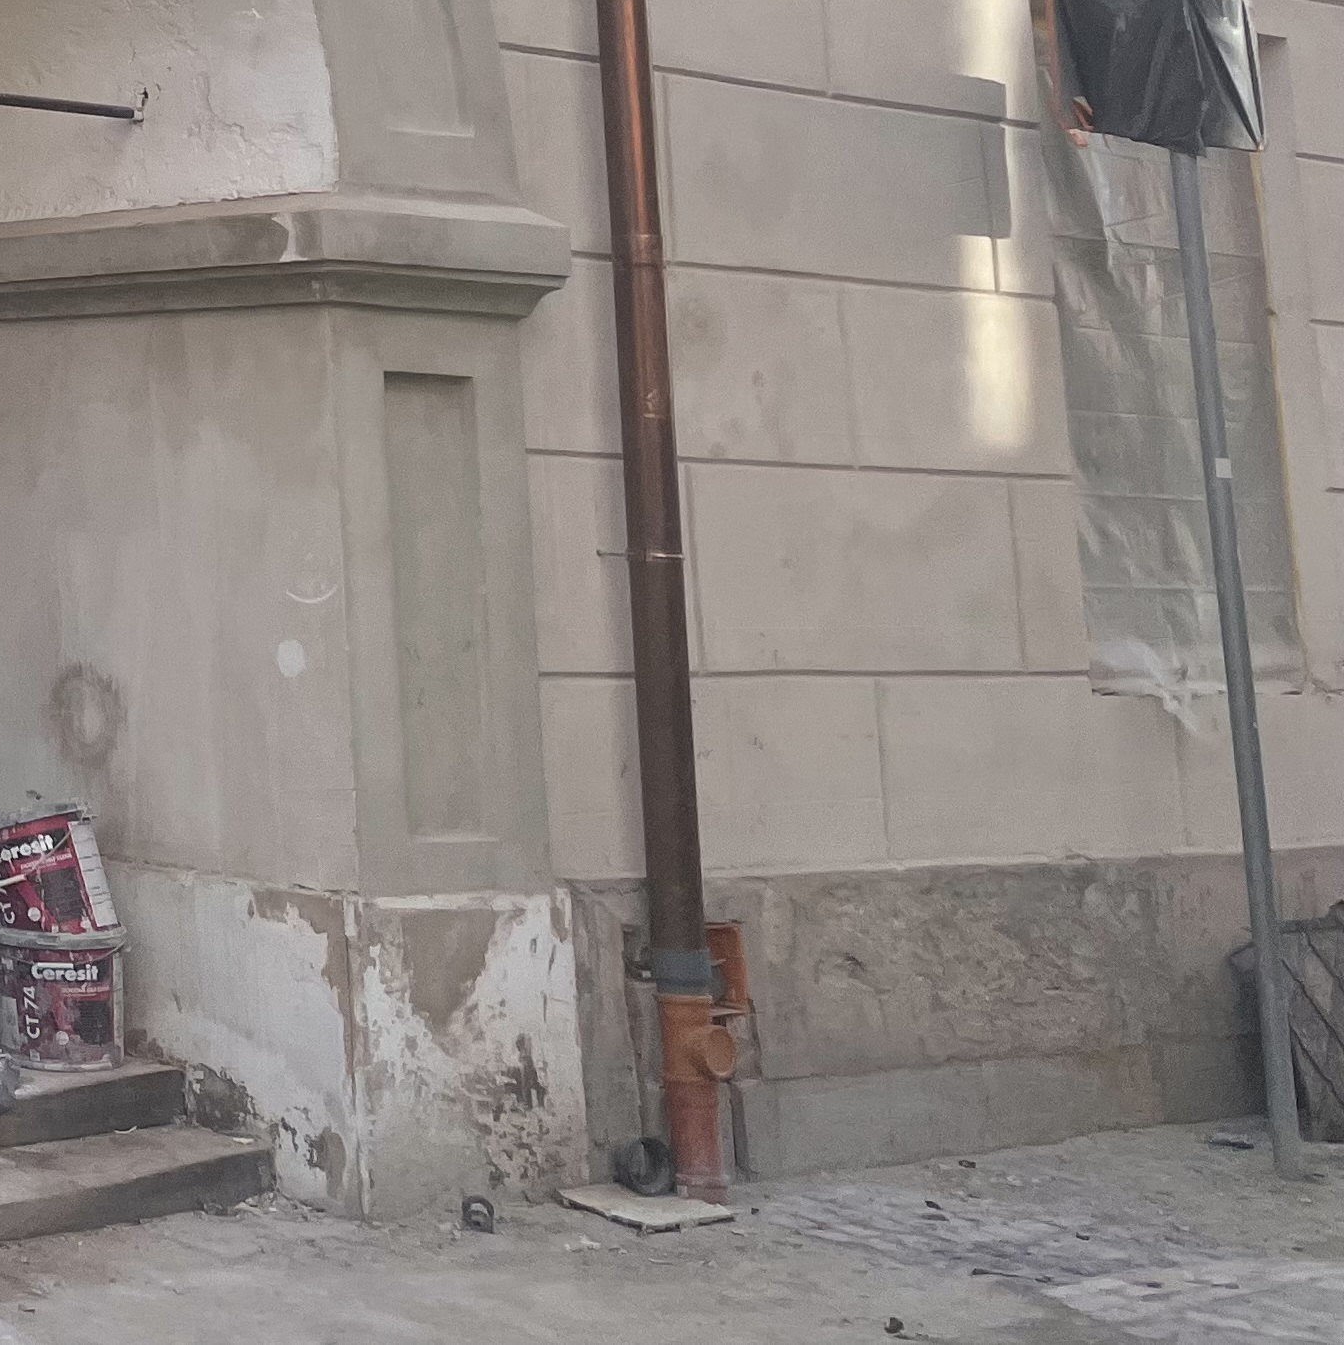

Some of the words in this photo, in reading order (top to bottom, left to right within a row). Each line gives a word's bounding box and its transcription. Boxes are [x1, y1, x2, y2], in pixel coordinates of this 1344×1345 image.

[0, 901, 16, 924] CT
[31, 963, 99, 981] Ceresit
[23, 986, 39, 1009] 74
[25, 1015, 40, 1039] CT
